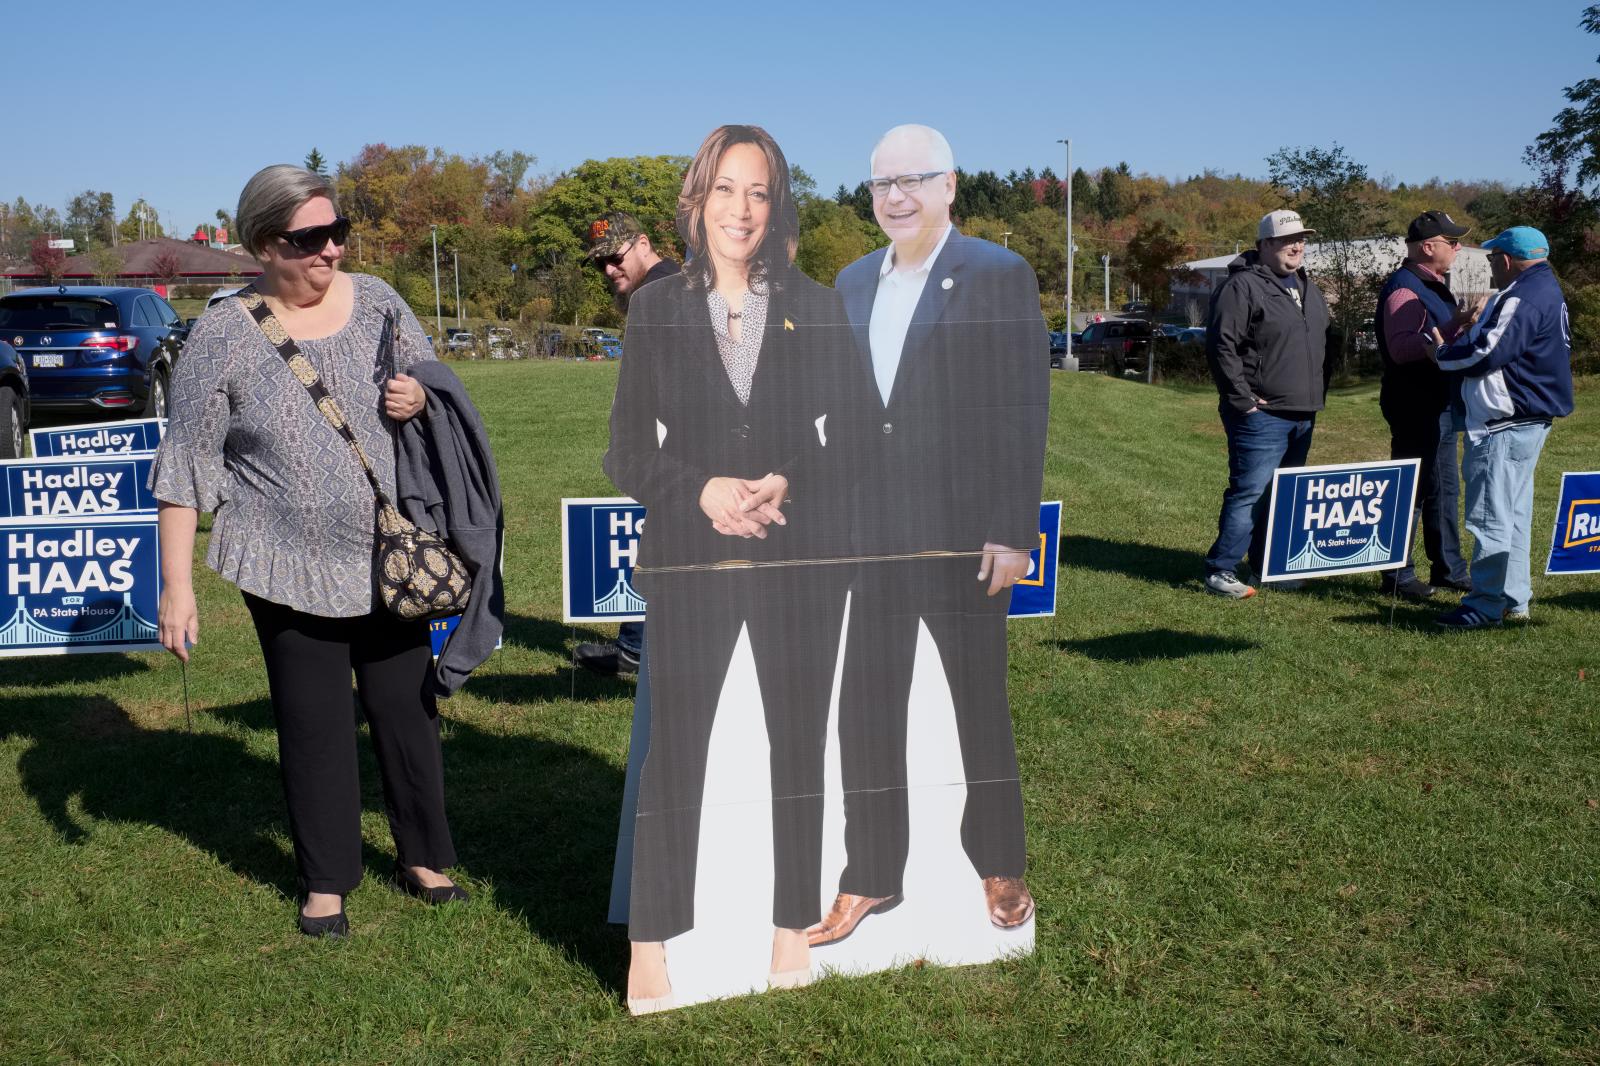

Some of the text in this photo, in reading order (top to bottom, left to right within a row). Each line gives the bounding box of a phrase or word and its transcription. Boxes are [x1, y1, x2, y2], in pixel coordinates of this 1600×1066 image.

[60, 429, 136, 450] Hadley
[22, 466, 123, 489] Hadley
[1306, 474, 1390, 501] Hadley
[23, 488, 121, 517] HAAS
[1303, 497, 1383, 530] HAAS
[8, 529, 140, 560] Hadley
[1316, 537, 1368, 548] PA State House
[8, 559, 135, 595] HAAS
[33, 606, 116, 618] PA State House
